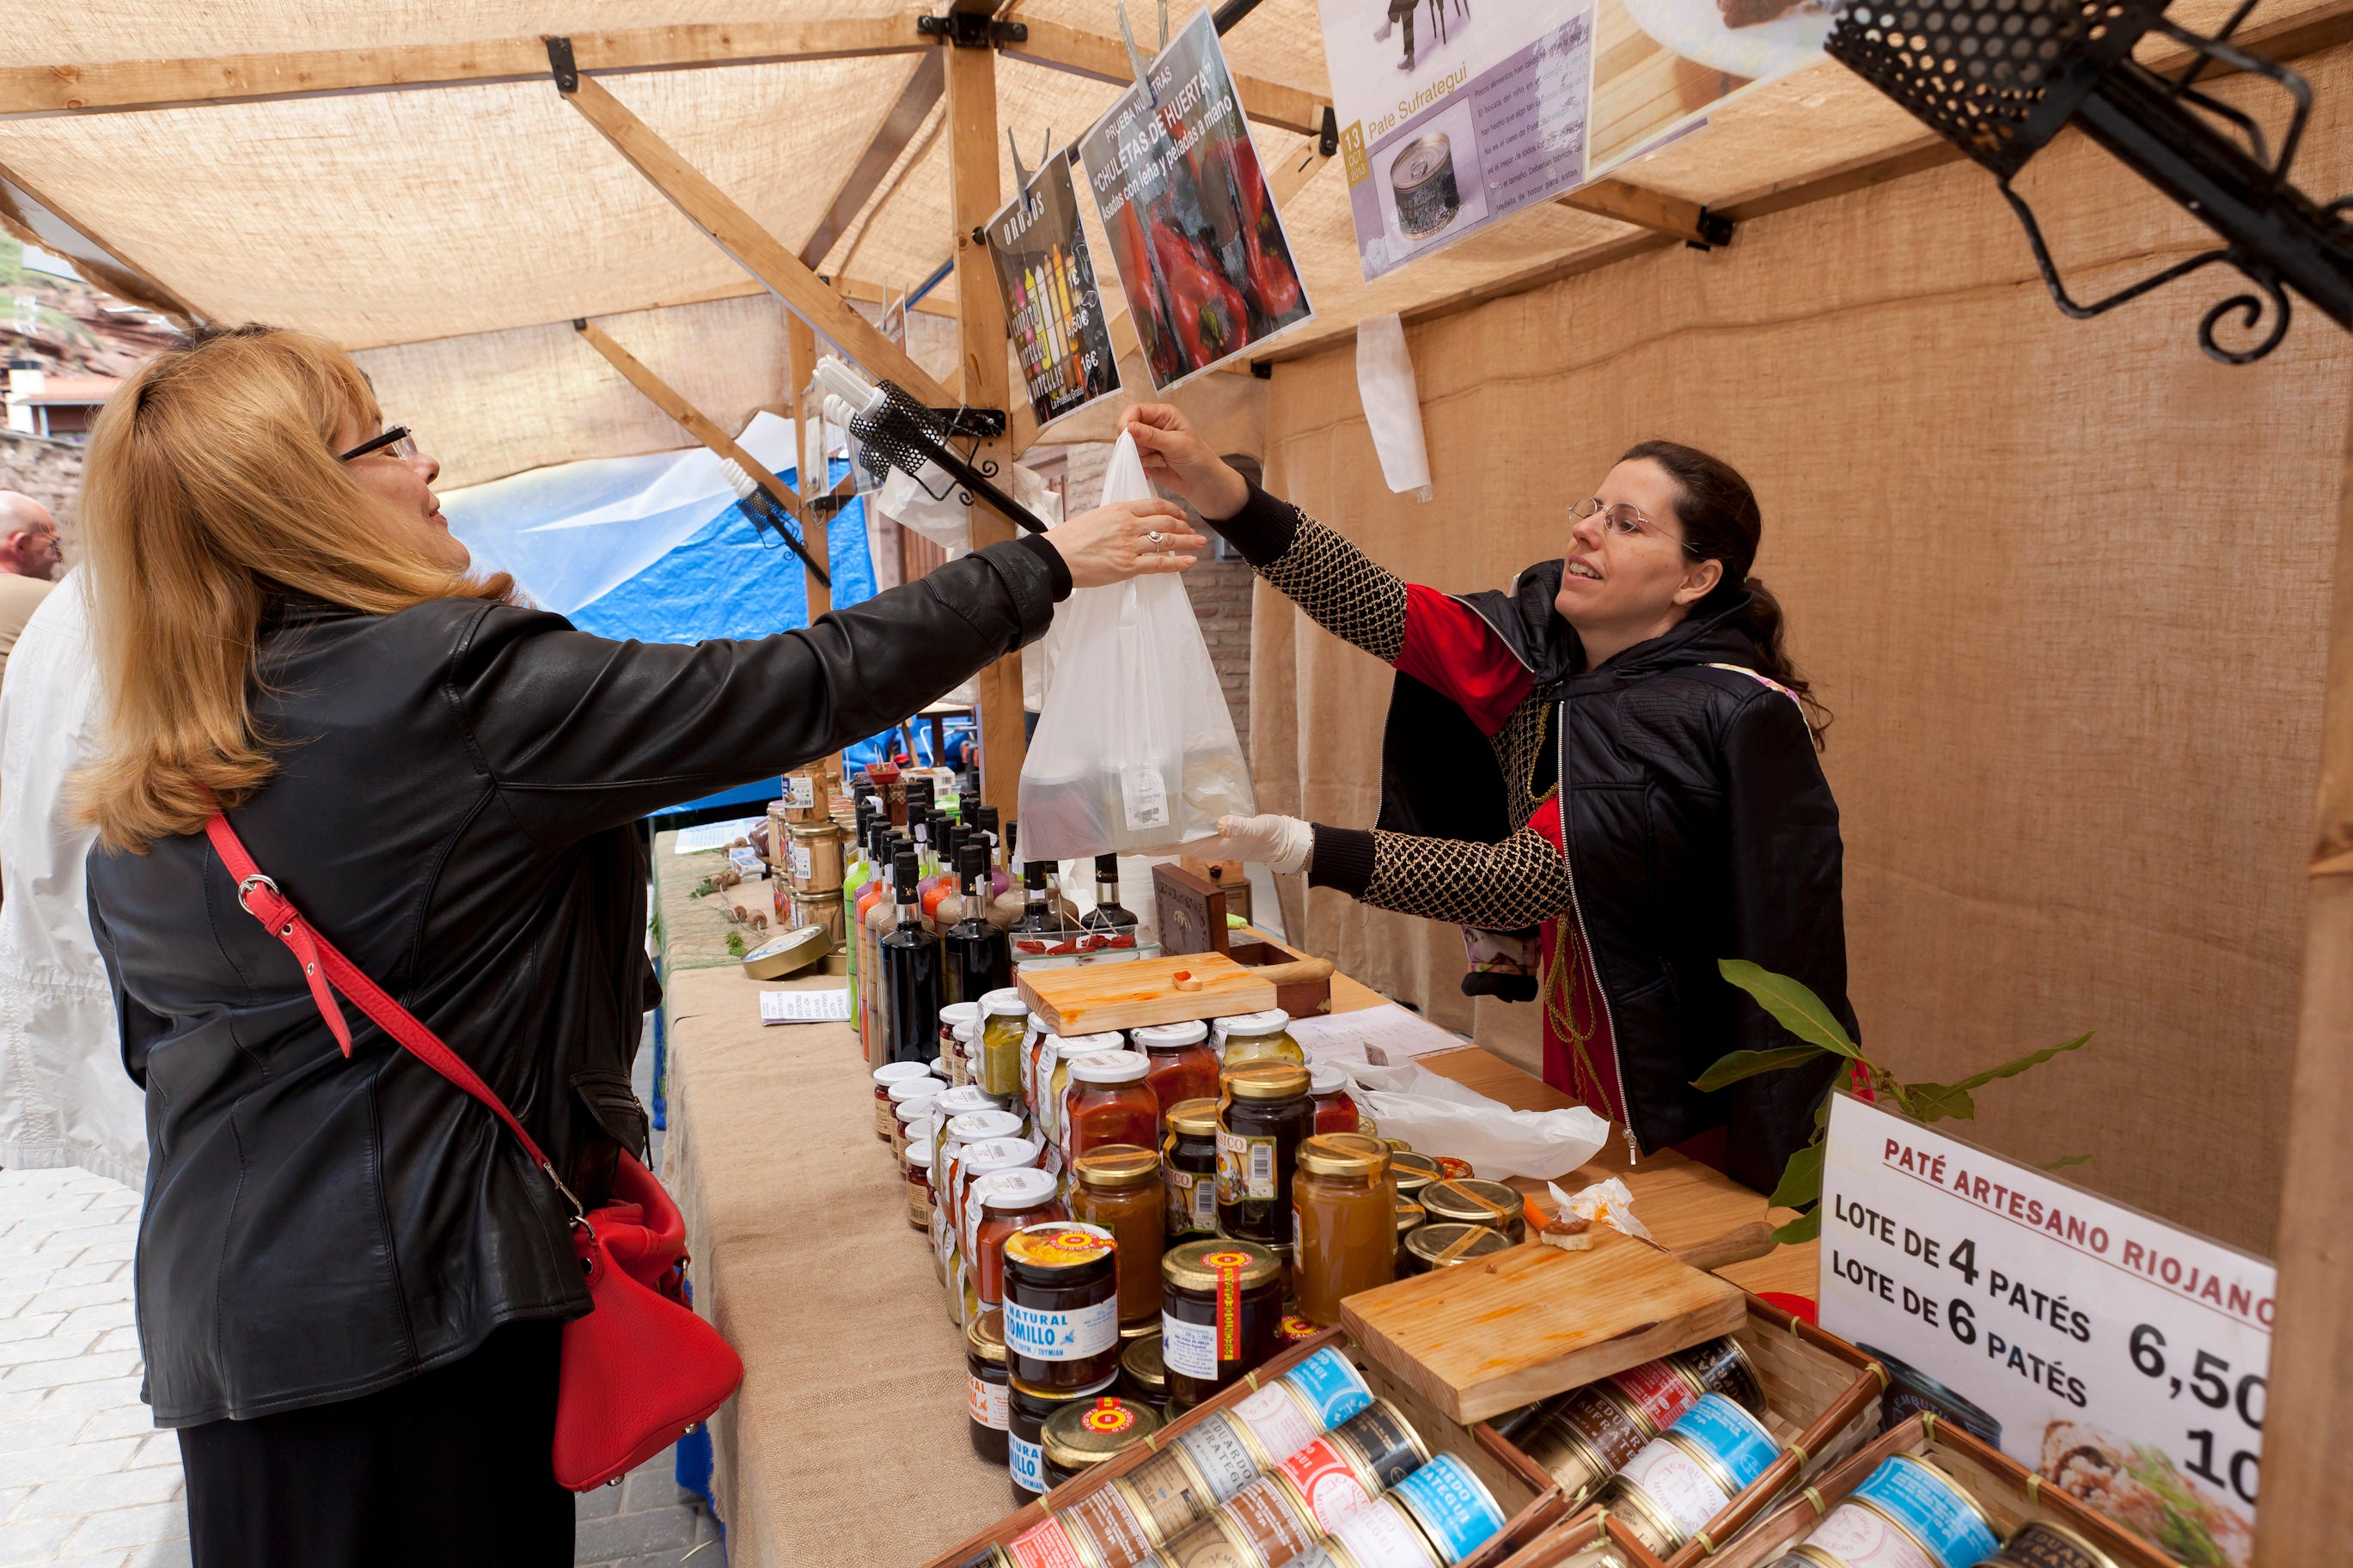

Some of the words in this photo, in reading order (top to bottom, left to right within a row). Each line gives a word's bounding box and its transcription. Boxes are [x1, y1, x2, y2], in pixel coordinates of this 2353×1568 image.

[1368, 113, 1396, 140] Pate
[1398, 61, 1468, 119] Sufrategui
[1105, 106, 1135, 143] PRUEBA
[1148, 113, 1166, 143] DE
[1345, 128, 1360, 152] 13
[1101, 191, 1124, 223] Asadas
[1124, 175, 1139, 201] con
[1139, 156, 1159, 187] leña
[1158, 155, 1166, 177] y
[1166, 125, 1199, 170] peladas
[1197, 120, 1204, 136] a
[1203, 95, 1232, 130] mano
[1348, 149, 1362, 168] OCT
[1350, 163, 1366, 182] 2013
[1067, 268, 1080, 287] 1€
[1066, 309, 1089, 338] 8,50€
[1080, 350, 1098, 372] 16€
[1885, 1138, 1946, 1185] PATÉ
[1953, 1169, 2109, 1254] ARTESANO
[1836, 1193, 1896, 1248] LOTE
[1904, 1227, 1940, 1269] DE
[1948, 1238, 1979, 1287] 4
[1989, 1269, 2090, 1344] PATÉS
[1009, 1304, 1068, 1326] NATURAL
[1225, 1303, 1232, 1313] DE
[1006, 1315, 1055, 1345] TOMILLO
[1833, 1249, 1895, 1304] LOTE
[1903, 1285, 1939, 1328] DE
[1948, 1298, 1977, 1345] 6
[1988, 1332, 2087, 1409] PATÉS
[1038, 1348, 1064, 1357] THYMIAN
[1083, 1408, 1098, 1431] CALIDAD
[1111, 1406, 1134, 1432] PRODUCTO
[1209, 1419, 1253, 1480] EDUARDO
